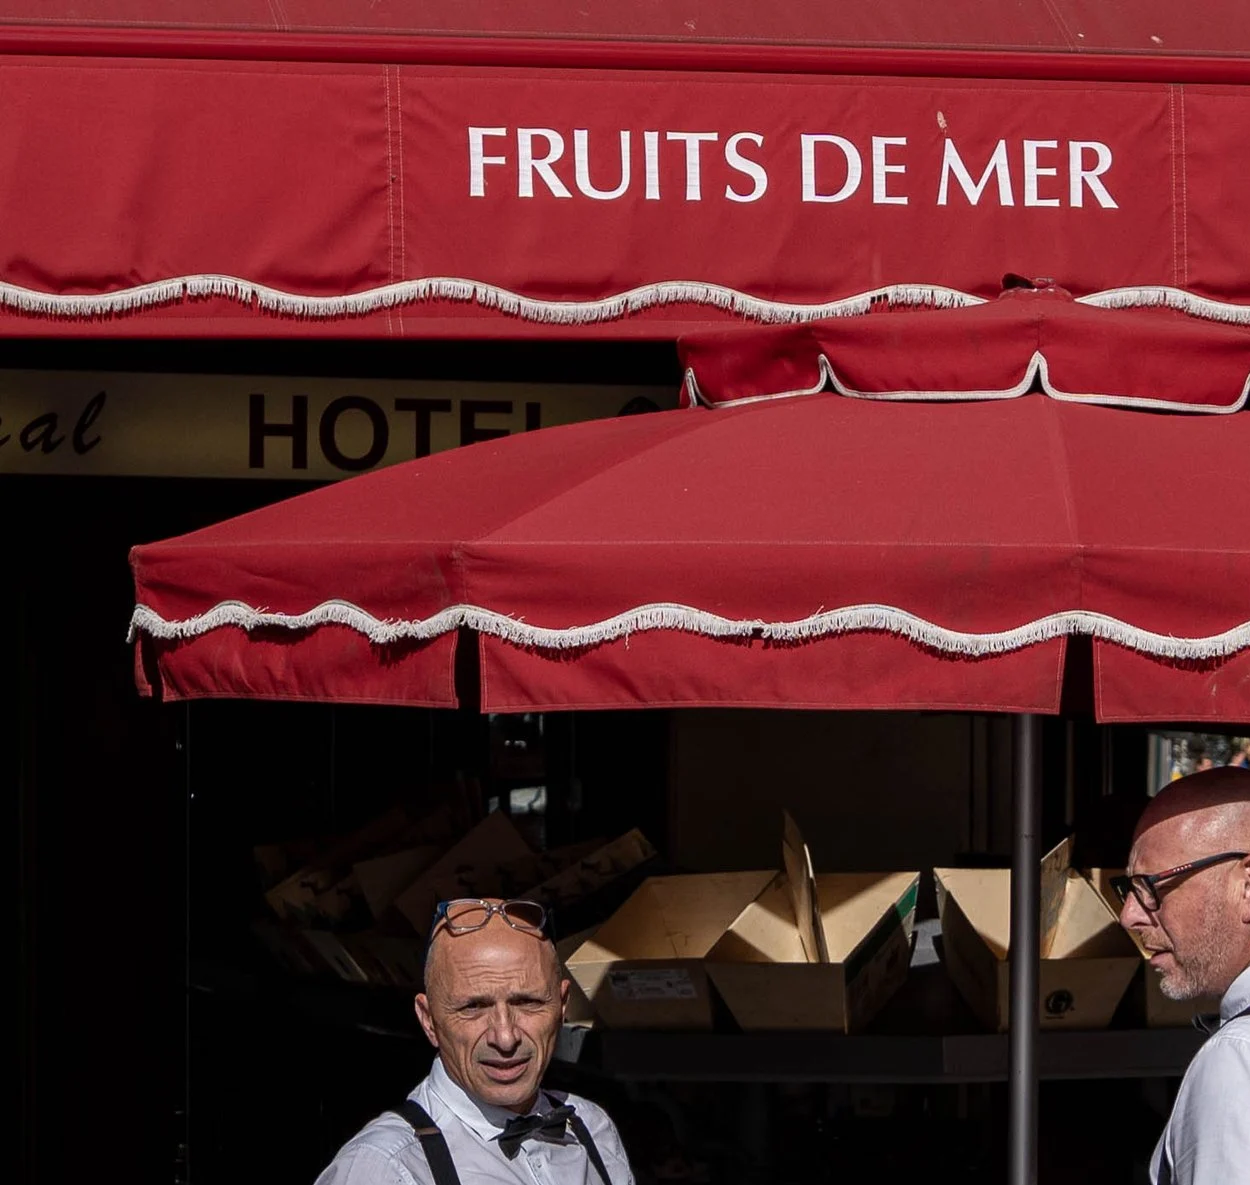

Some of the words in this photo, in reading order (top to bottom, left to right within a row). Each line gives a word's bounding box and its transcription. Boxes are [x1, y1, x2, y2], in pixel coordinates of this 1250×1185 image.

[468, 126, 768, 203] FRUITS
[801, 133, 909, 205] DE
[937, 138, 1119, 209] MER
